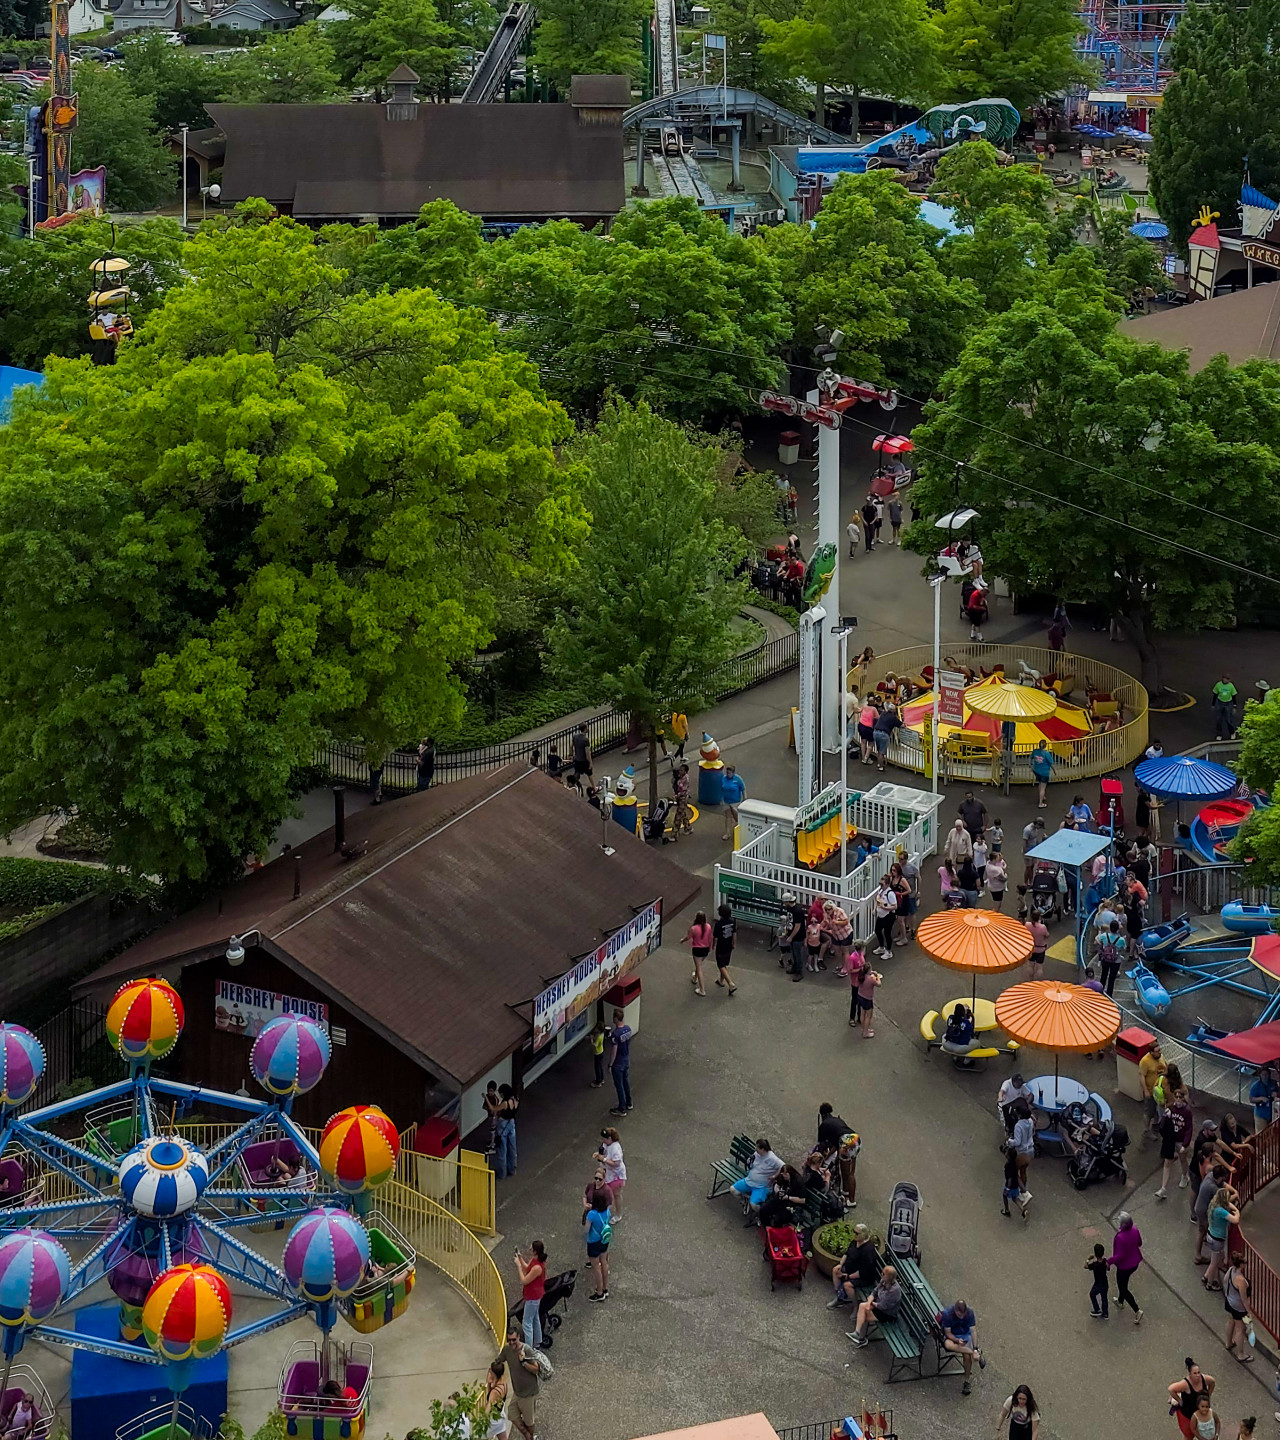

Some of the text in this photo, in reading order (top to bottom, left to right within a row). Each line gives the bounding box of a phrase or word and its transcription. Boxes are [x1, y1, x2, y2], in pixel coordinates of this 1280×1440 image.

[945, 689, 959, 698] NOW
[606, 905, 657, 960] COOKIE HOUSE
[220, 981, 325, 1022] HERSHEY HOUSE
[535, 952, 599, 1017] HERSHEY HOUSE
